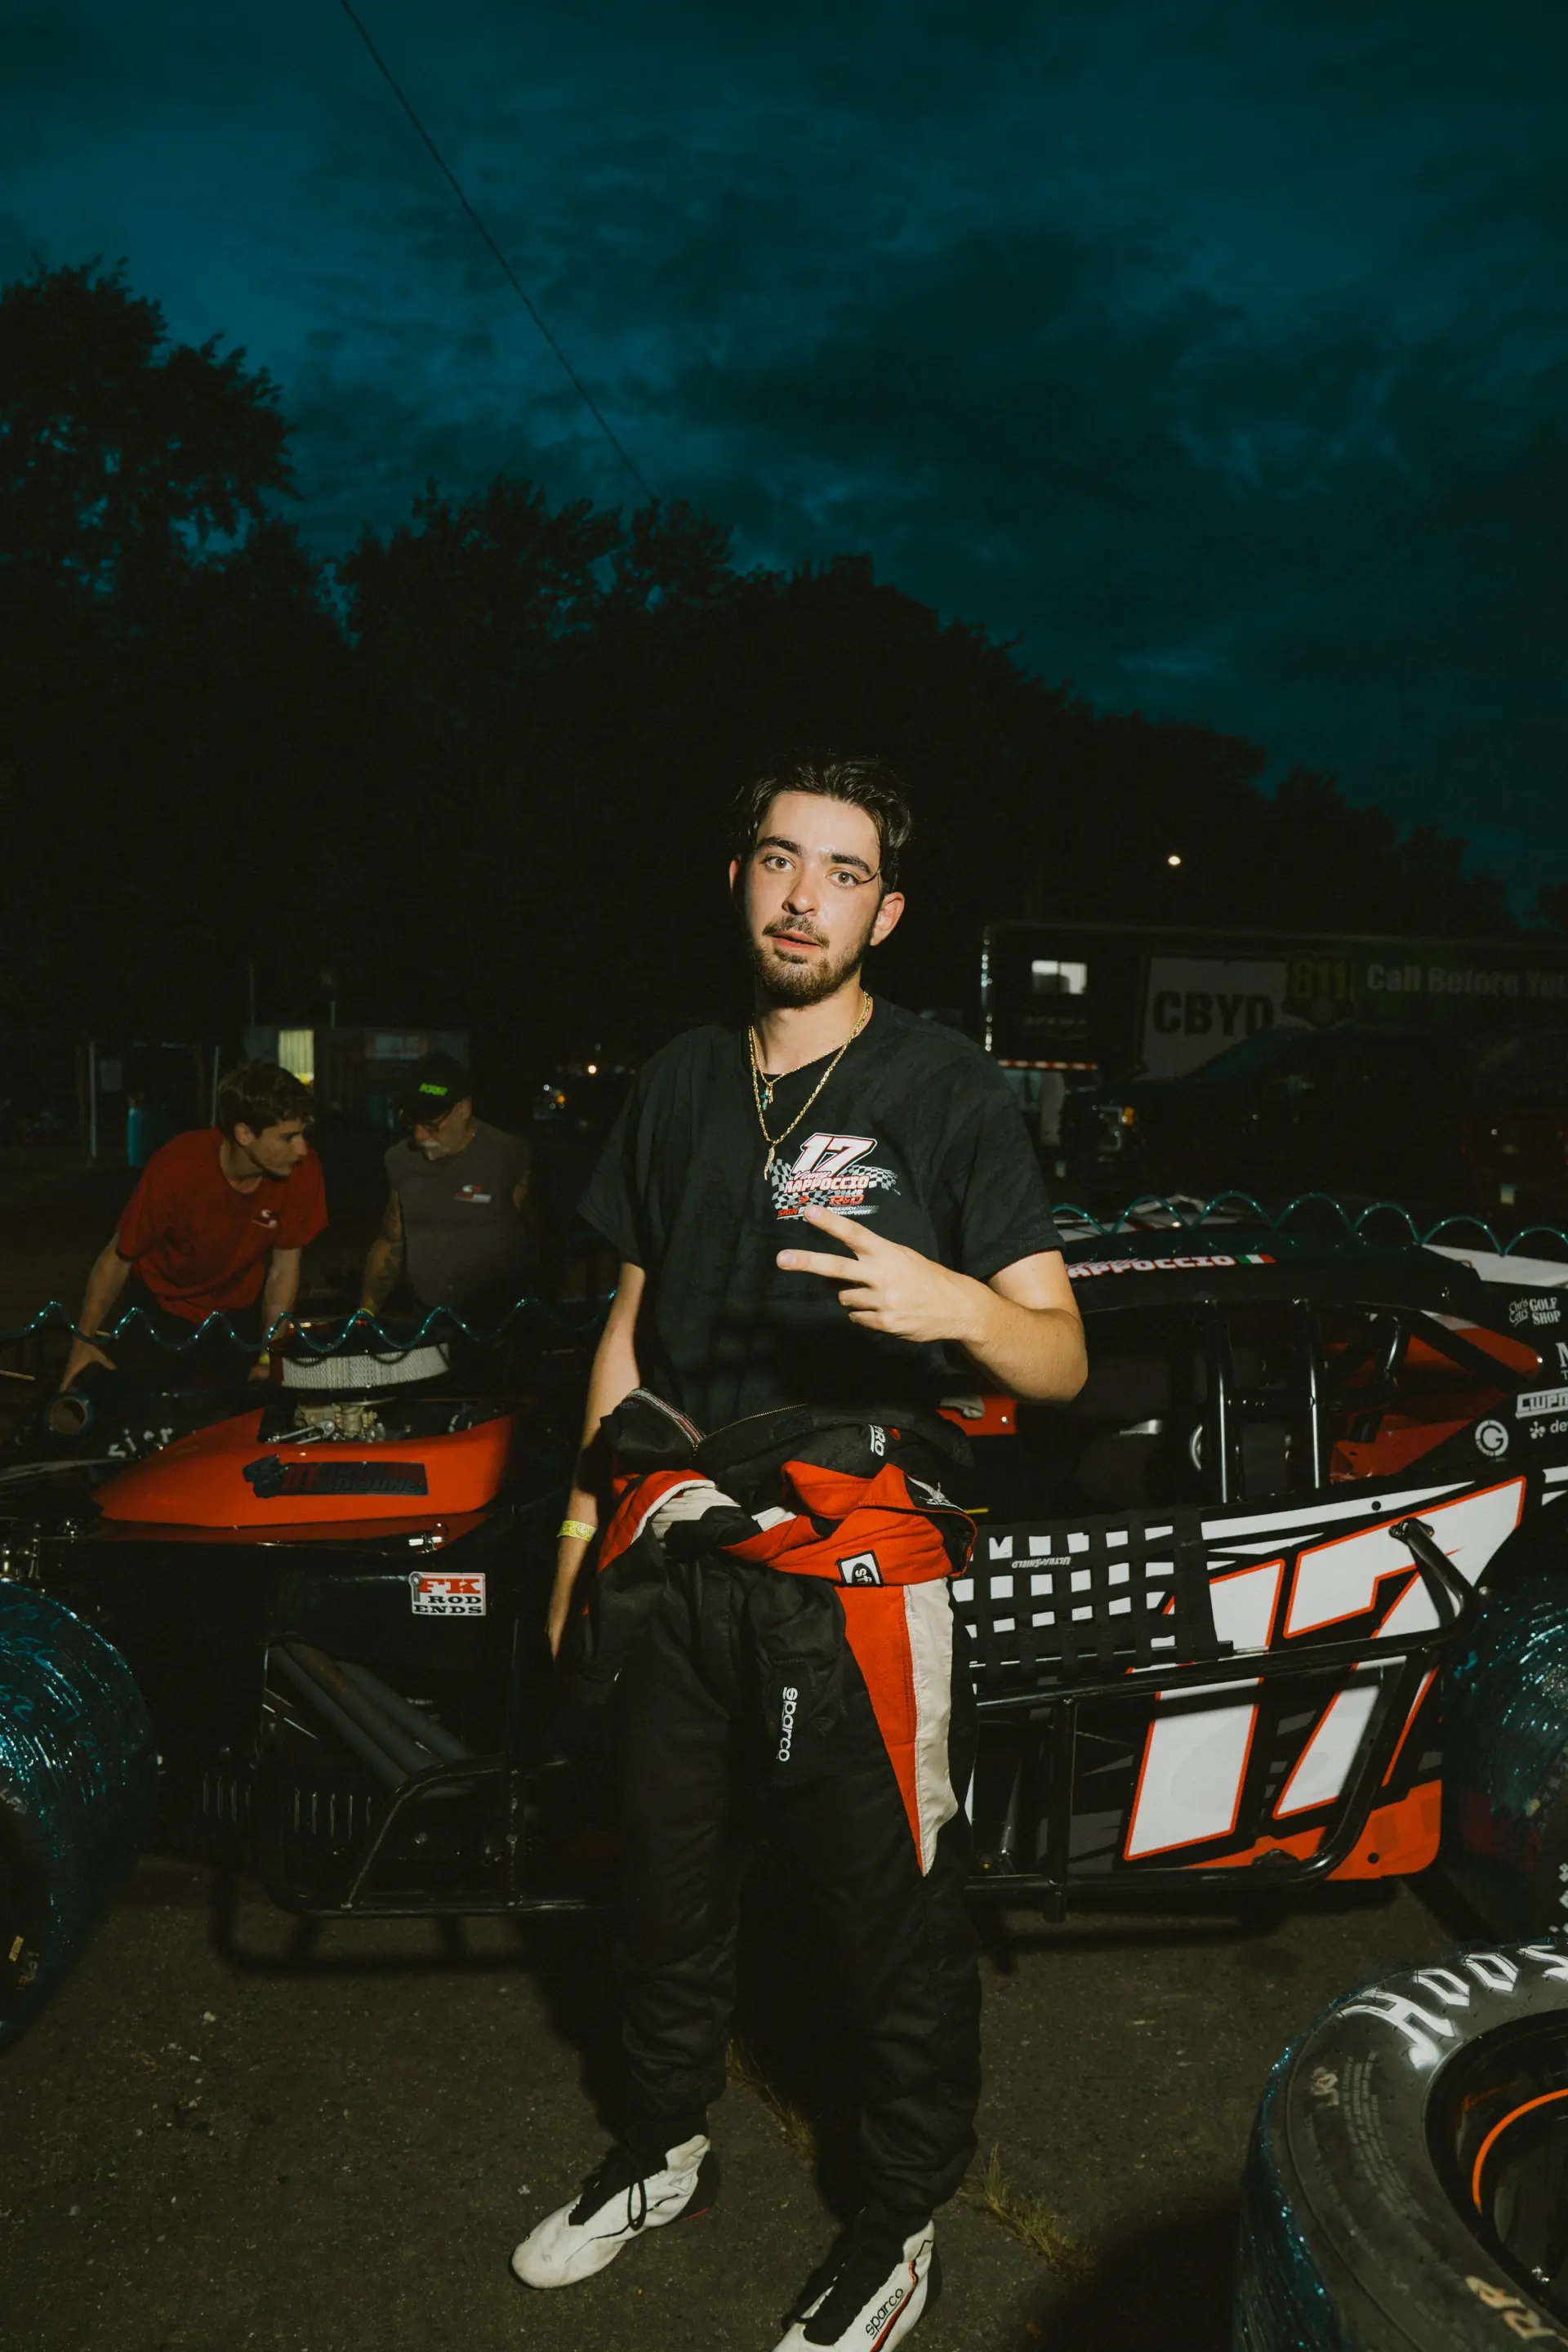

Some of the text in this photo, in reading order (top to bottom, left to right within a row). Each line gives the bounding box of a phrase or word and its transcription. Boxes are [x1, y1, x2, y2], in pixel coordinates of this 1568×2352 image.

[1366, 964, 1421, 992] Call
[1428, 967, 1519, 997] Before
[1152, 991, 1274, 1037] CBYD
[790, 1133, 877, 1177] 17
[777, 1208, 798, 1217] SIGN
[1066, 1254, 1236, 1279] APPOCCIO
[1529, 1297, 1557, 1311] GOLF
[1532, 1310, 1561, 1325] SHOP
[419, 1578, 480, 1594] FK
[855, 1568, 872, 1584] sf
[413, 1604, 482, 1614] ENDS
[428, 1595, 481, 1604] ROD
[1124, 1475, 1526, 1863] 17
[778, 1687, 798, 1762] sparco
[866, 2288, 904, 2336] sparco
